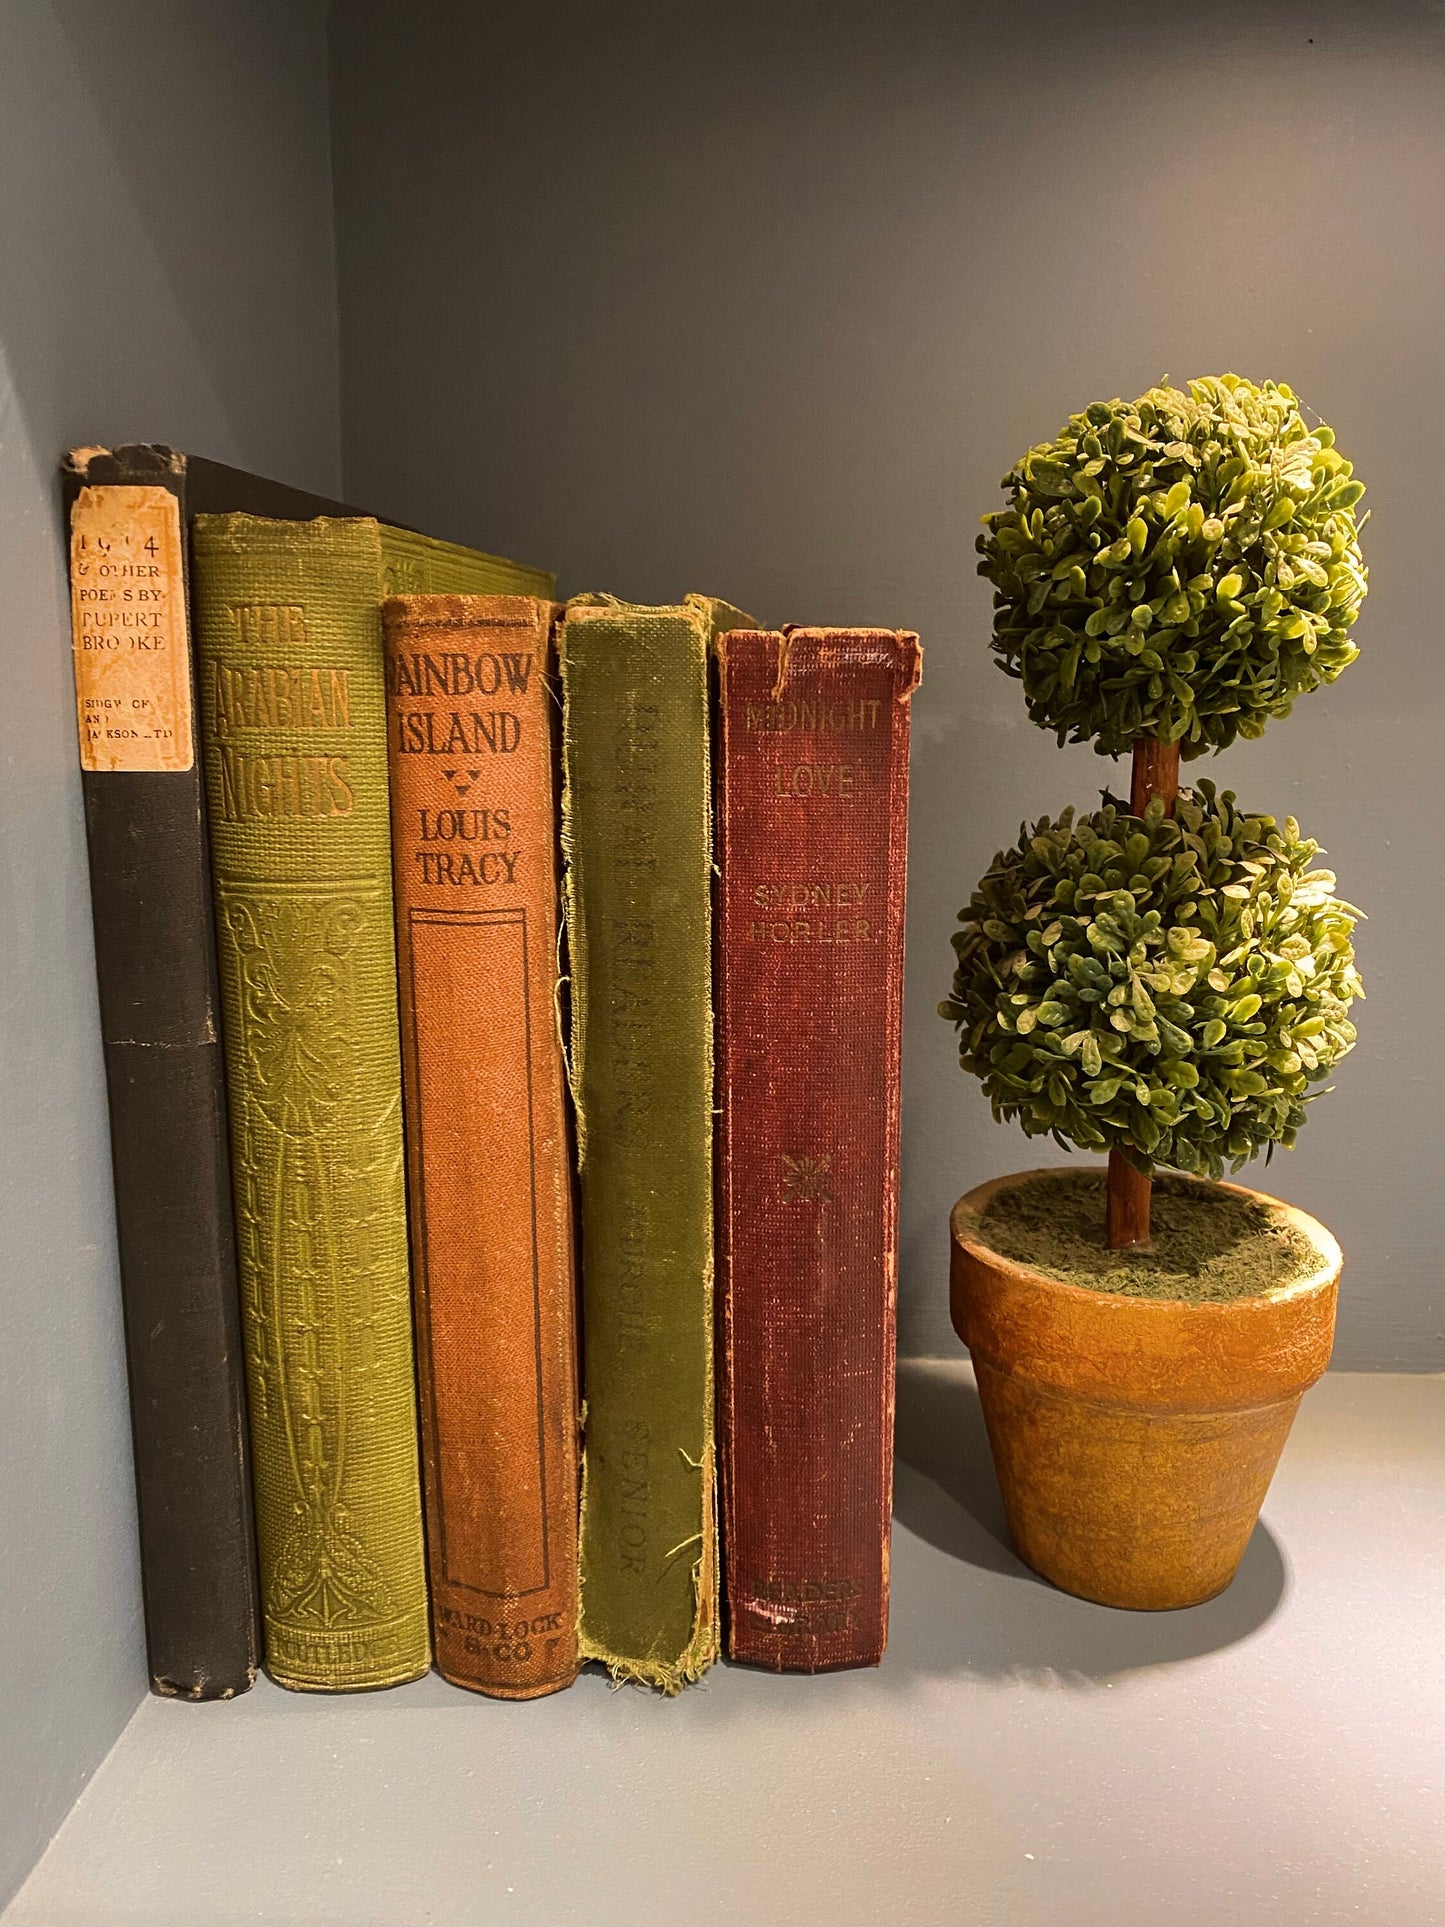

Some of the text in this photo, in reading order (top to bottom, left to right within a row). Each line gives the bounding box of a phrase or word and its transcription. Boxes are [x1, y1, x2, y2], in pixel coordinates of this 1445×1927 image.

[80, 589, 162, 602] POES BY
[389, 652, 534, 697] AINBOW
[397, 711, 521, 754] ISLAND
[746, 700, 881, 734] MIDNIGHT
[216, 747, 354, 822] NIGHTS
[774, 764, 854, 797] LOVE
[417, 808, 512, 842] LOUIS
[415, 850, 521, 886] TRACY
[753, 883, 872, 907] SYDNEY
[750, 919, 872, 943] HORLER
[499, 1611, 563, 1641] LOCK
